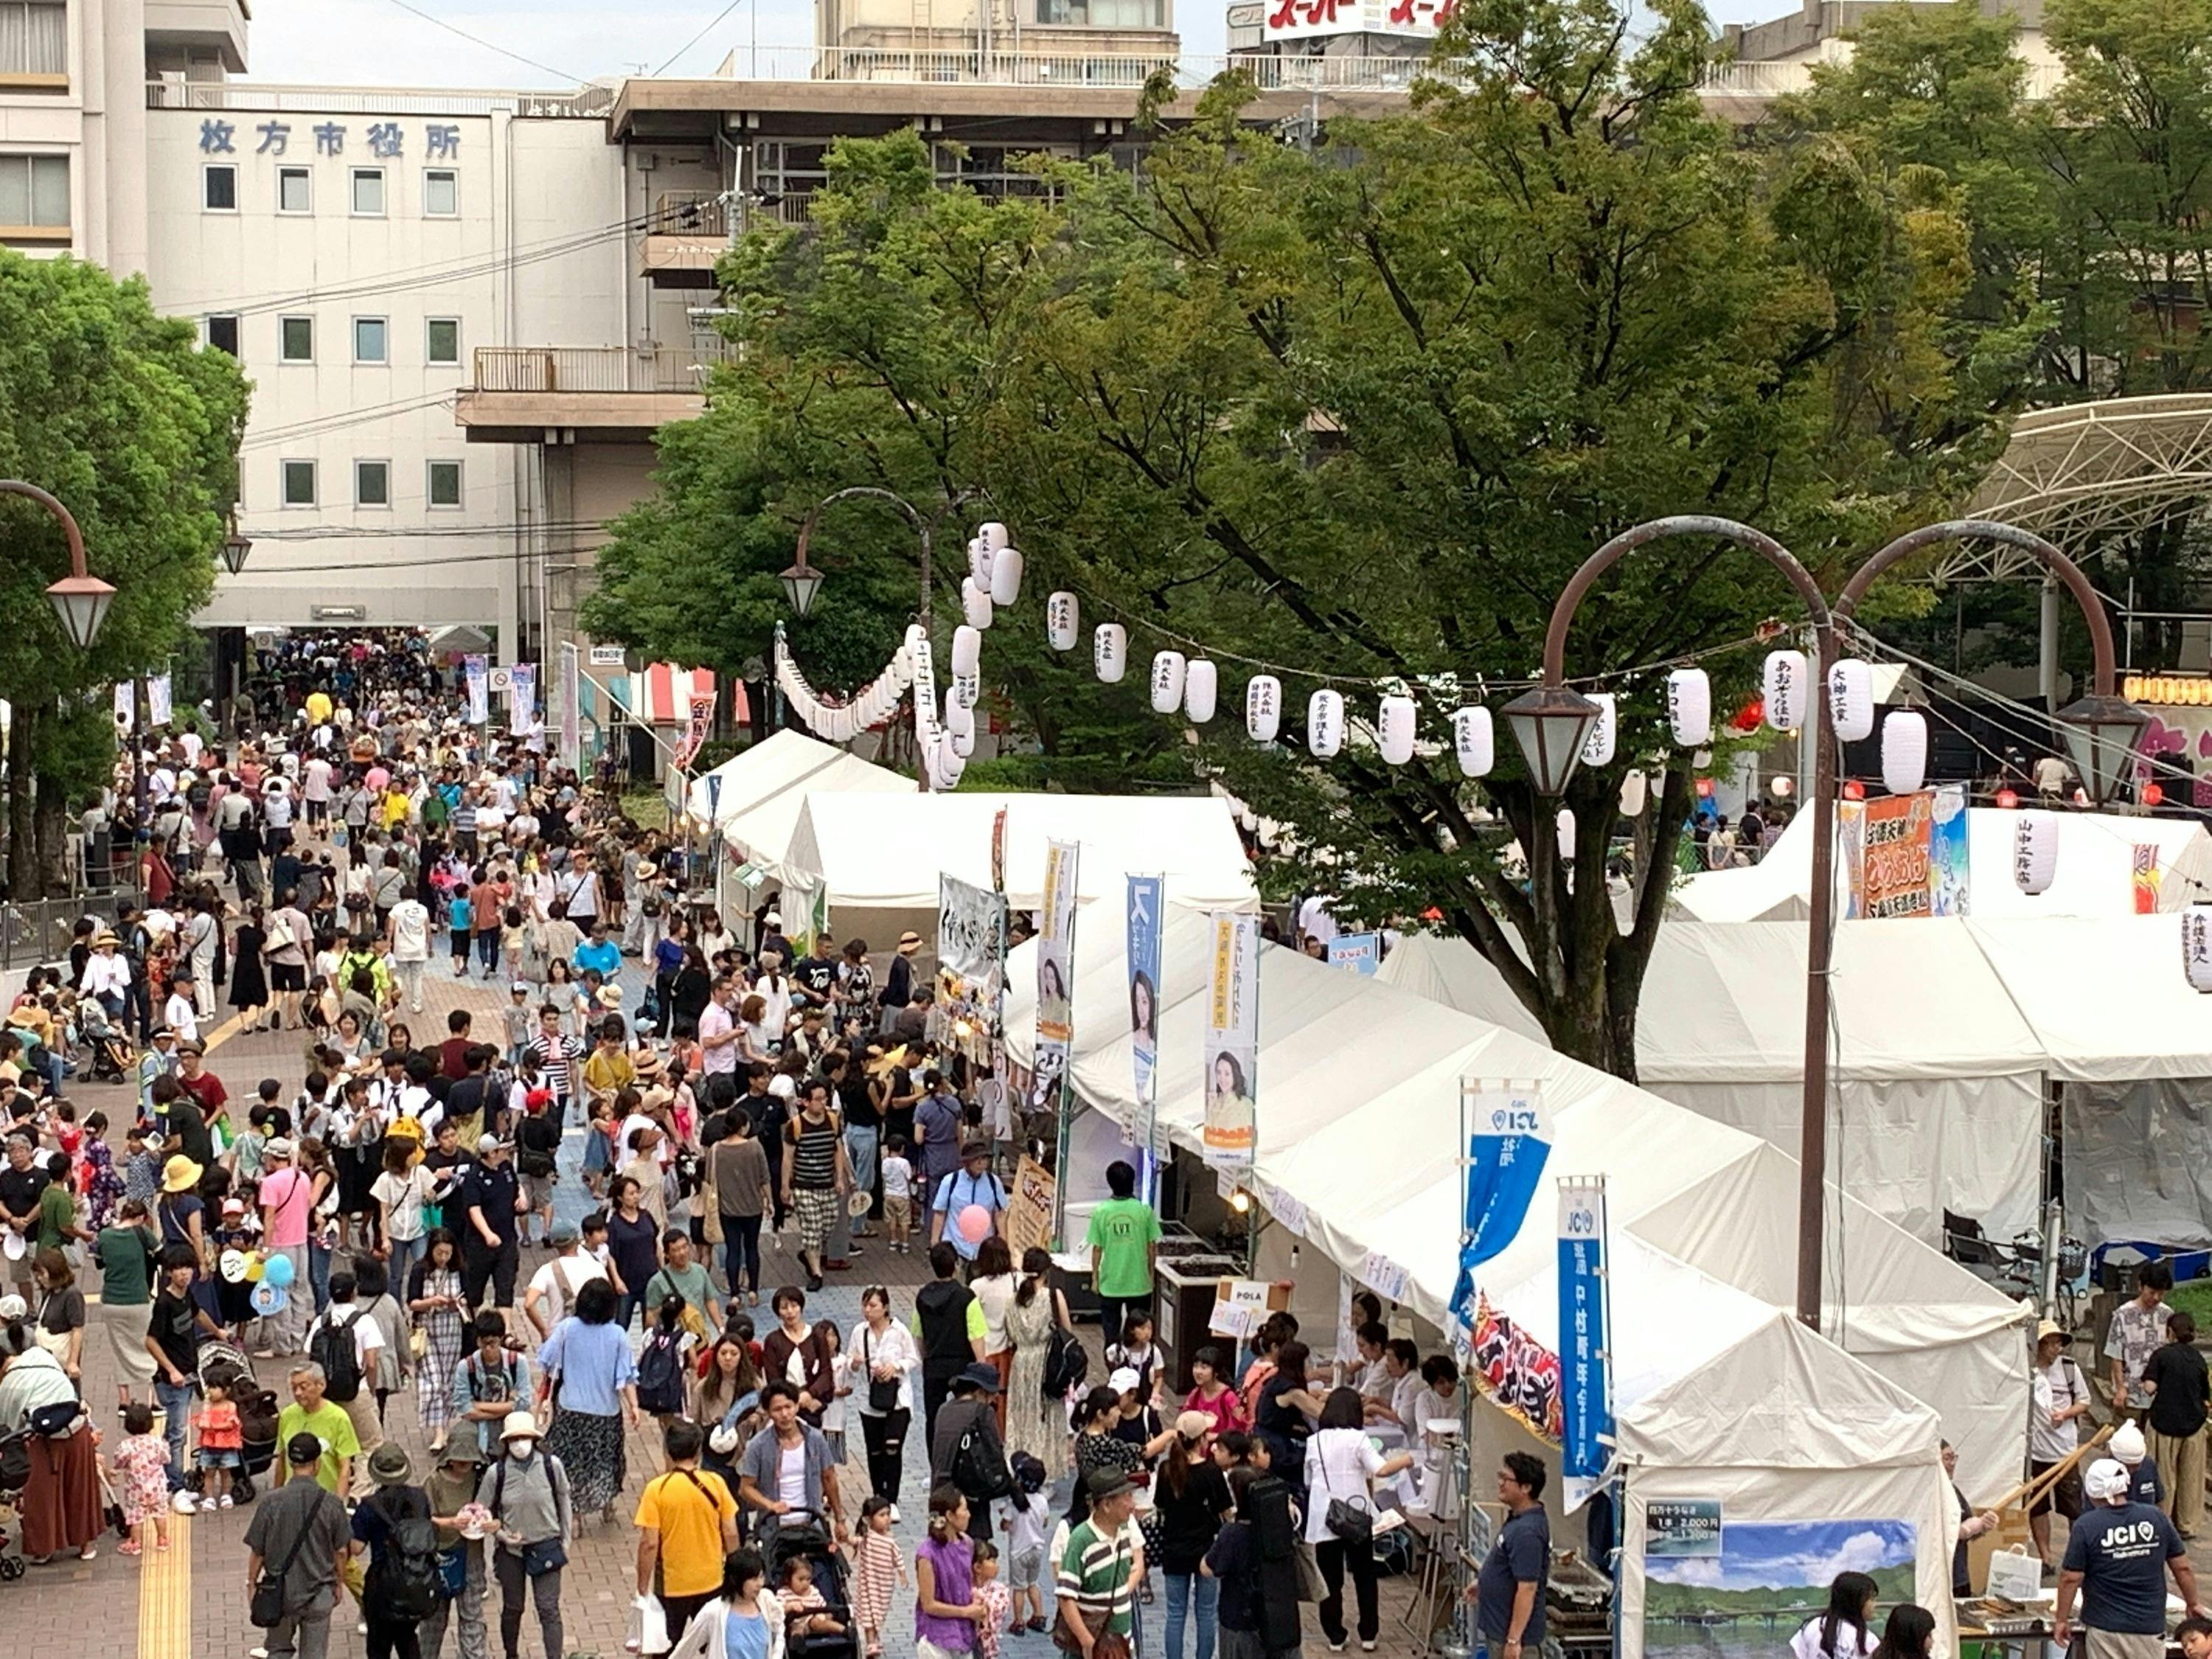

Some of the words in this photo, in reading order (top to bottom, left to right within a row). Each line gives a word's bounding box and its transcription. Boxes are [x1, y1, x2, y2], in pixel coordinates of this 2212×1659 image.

[199, 118, 461, 160] 枚方市役所
[1237, 1291, 1262, 1301] POLA
[2100, 1524, 2137, 1548] JCI
